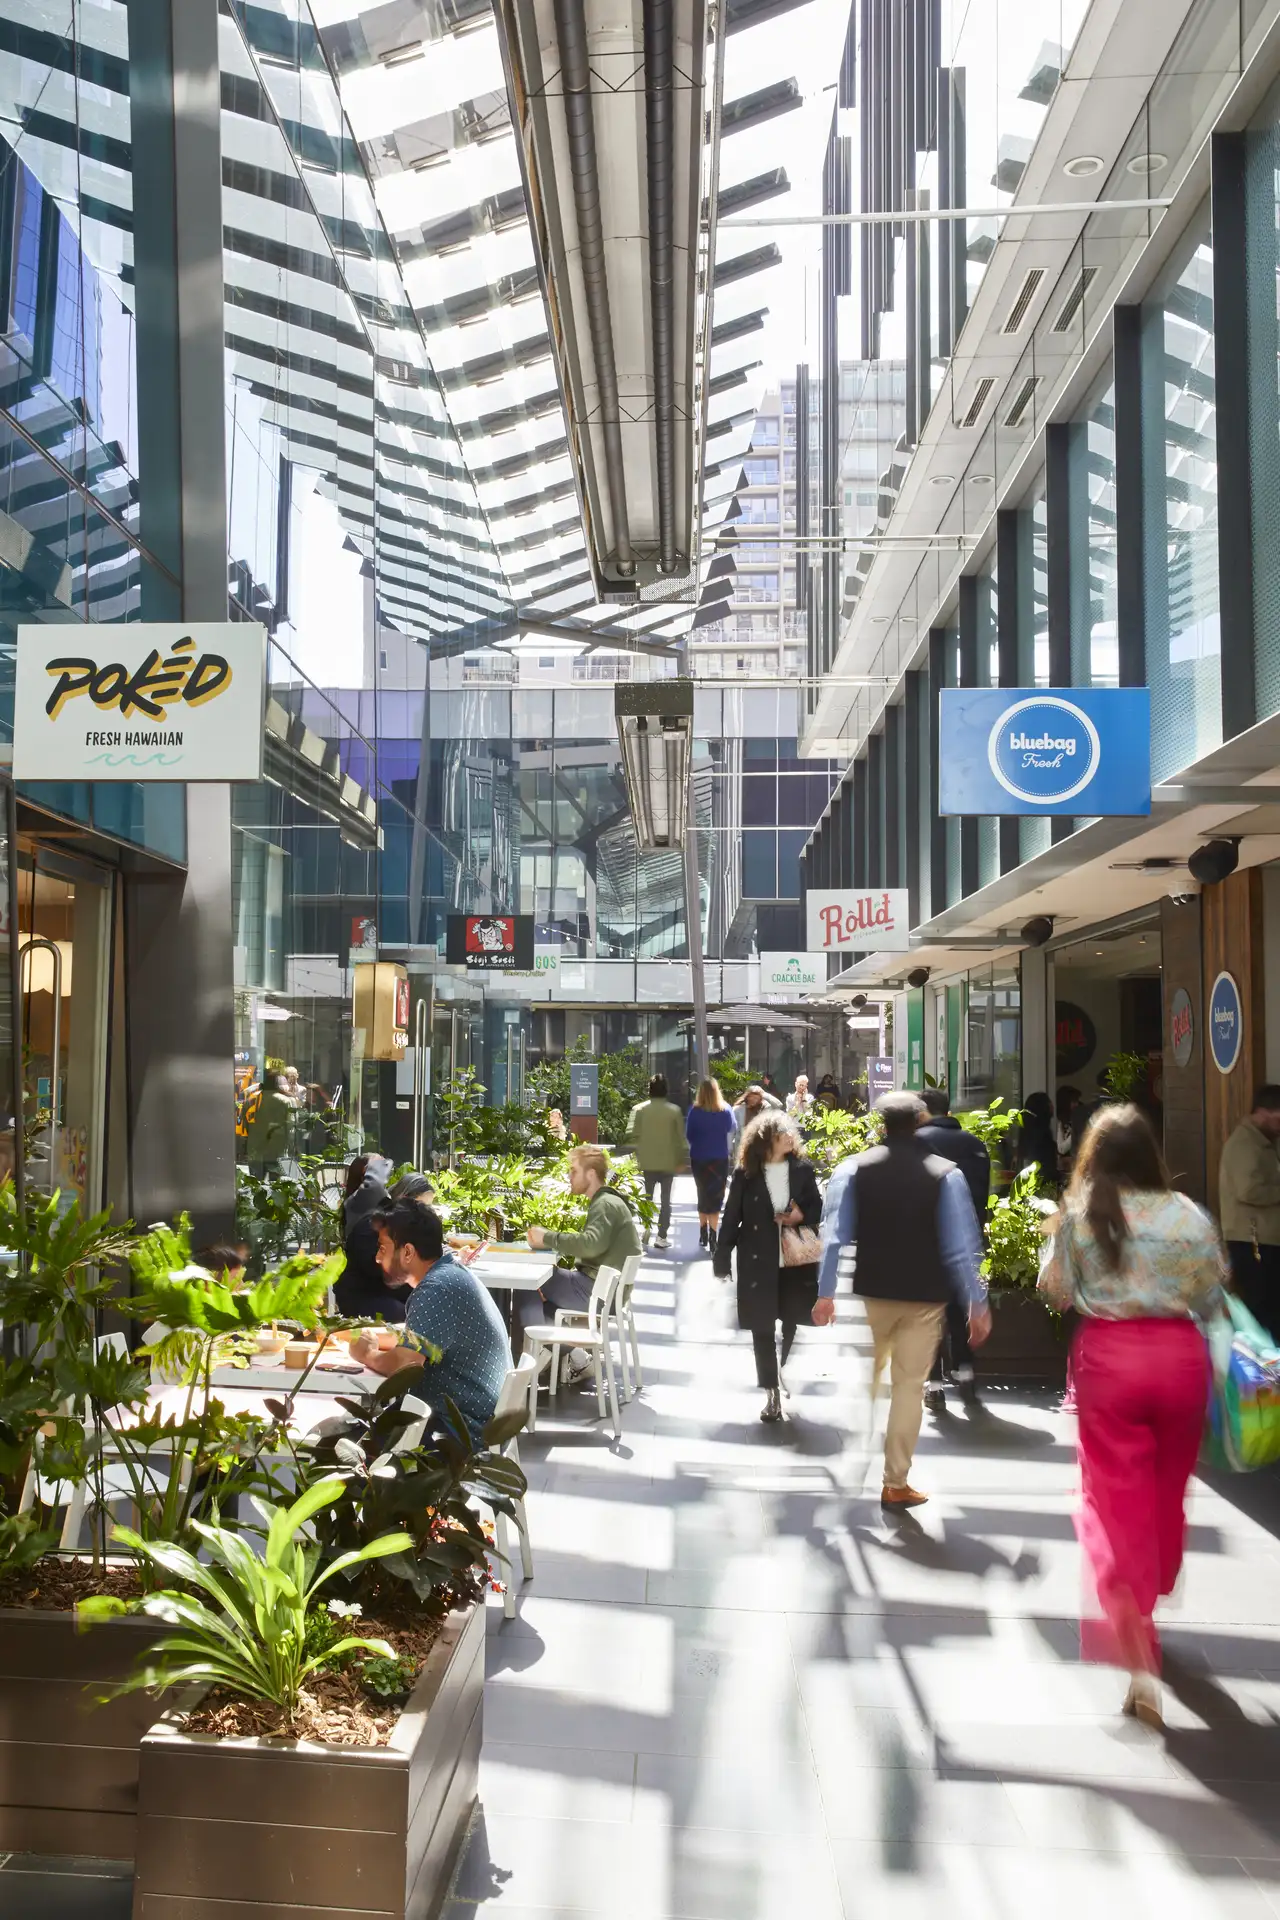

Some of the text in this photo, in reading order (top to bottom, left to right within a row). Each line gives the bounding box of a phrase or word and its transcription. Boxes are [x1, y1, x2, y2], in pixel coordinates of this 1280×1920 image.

[86, 731, 183, 746] FRESH HAWAIIAN
[1010, 732, 1076, 755] bluebag
[536, 956, 556, 969] GOS
[771, 973, 816, 983] CRACKLE BAE
